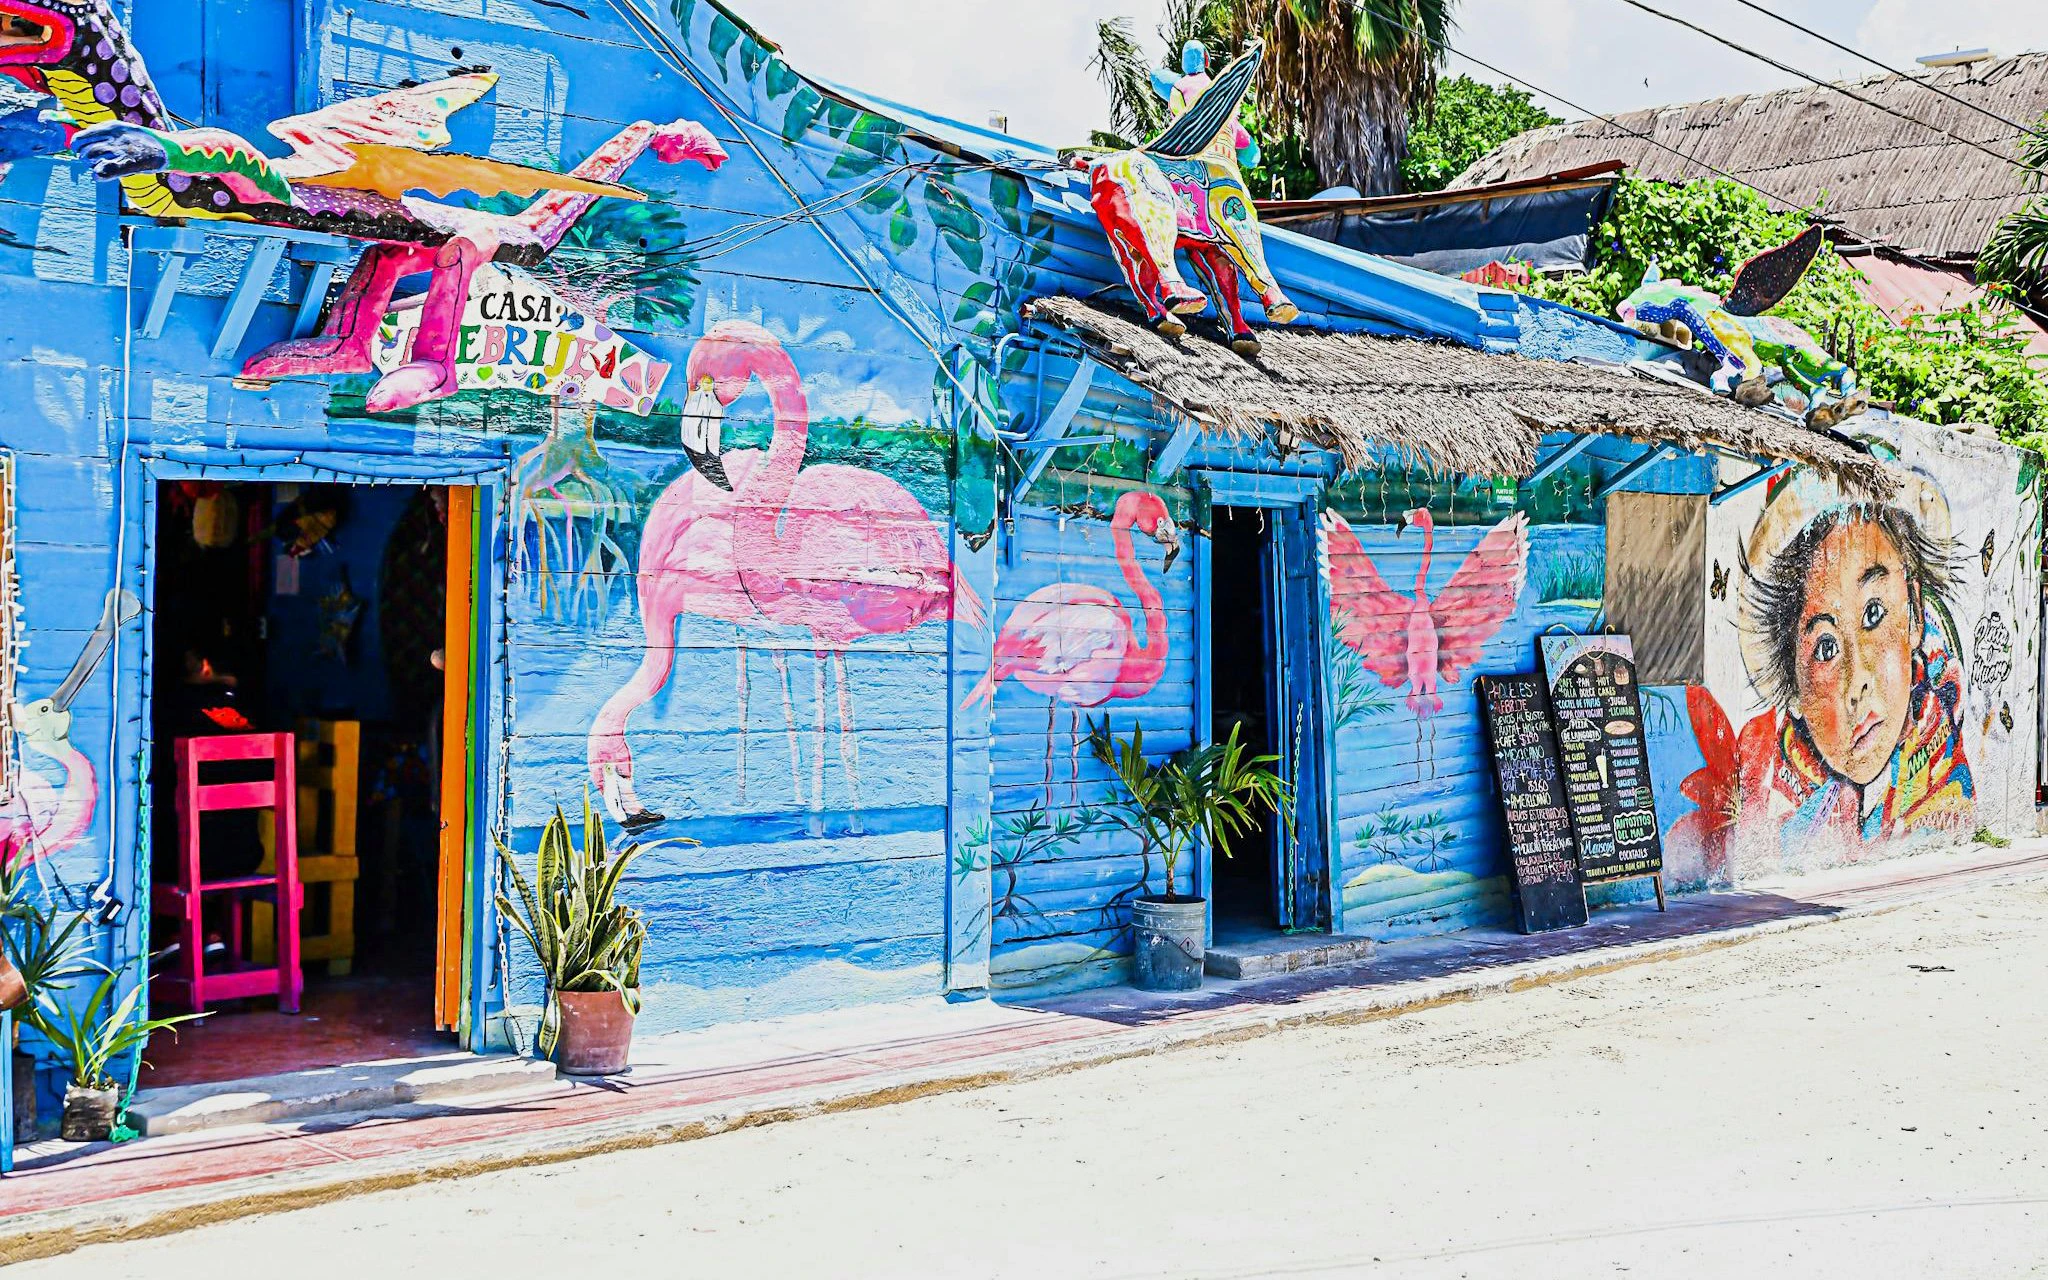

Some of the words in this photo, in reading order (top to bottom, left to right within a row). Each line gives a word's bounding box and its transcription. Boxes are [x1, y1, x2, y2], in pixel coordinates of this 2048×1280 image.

[480, 291, 552, 323] CASA
[399, 322, 598, 382] EBRIJE
[1598, 686, 1616, 697] CAKES
[1615, 815, 1651, 829] ANTOJITOS
[1618, 829, 1629, 840] DEL
[1630, 827, 1645, 838] MAR
